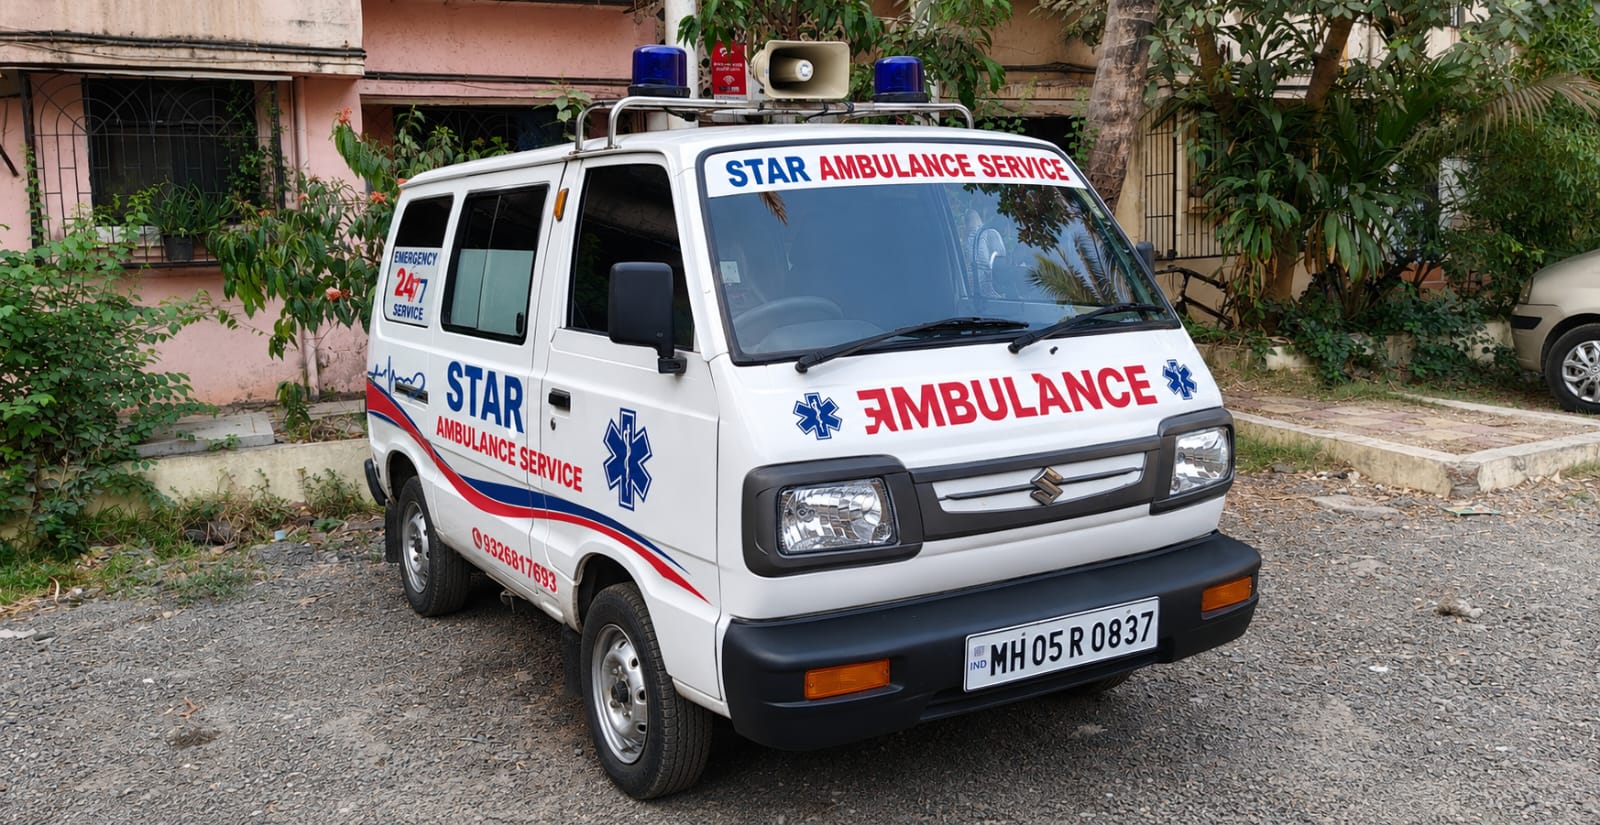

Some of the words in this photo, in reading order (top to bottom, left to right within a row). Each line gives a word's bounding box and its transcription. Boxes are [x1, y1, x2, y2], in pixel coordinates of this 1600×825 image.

[725, 156, 812, 188] STAR
[819, 153, 976, 181] AMBULANCE
[976, 154, 1070, 181] SERVICE
[394, 250, 438, 266] EMERGENCY
[393, 303, 424, 321] SERVICE
[446, 361, 525, 434] STAR
[436, 415, 516, 467] AMBULANCE
[519, 446, 583, 493] SERVICE
[483, 534, 558, 593] 9326817693
[970, 659, 988, 671] IND
[990, 637, 1026, 676] MH
[1032, 629, 1064, 666] 05
[1069, 626, 1085, 658] R
[1091, 611, 1154, 652] 0837
